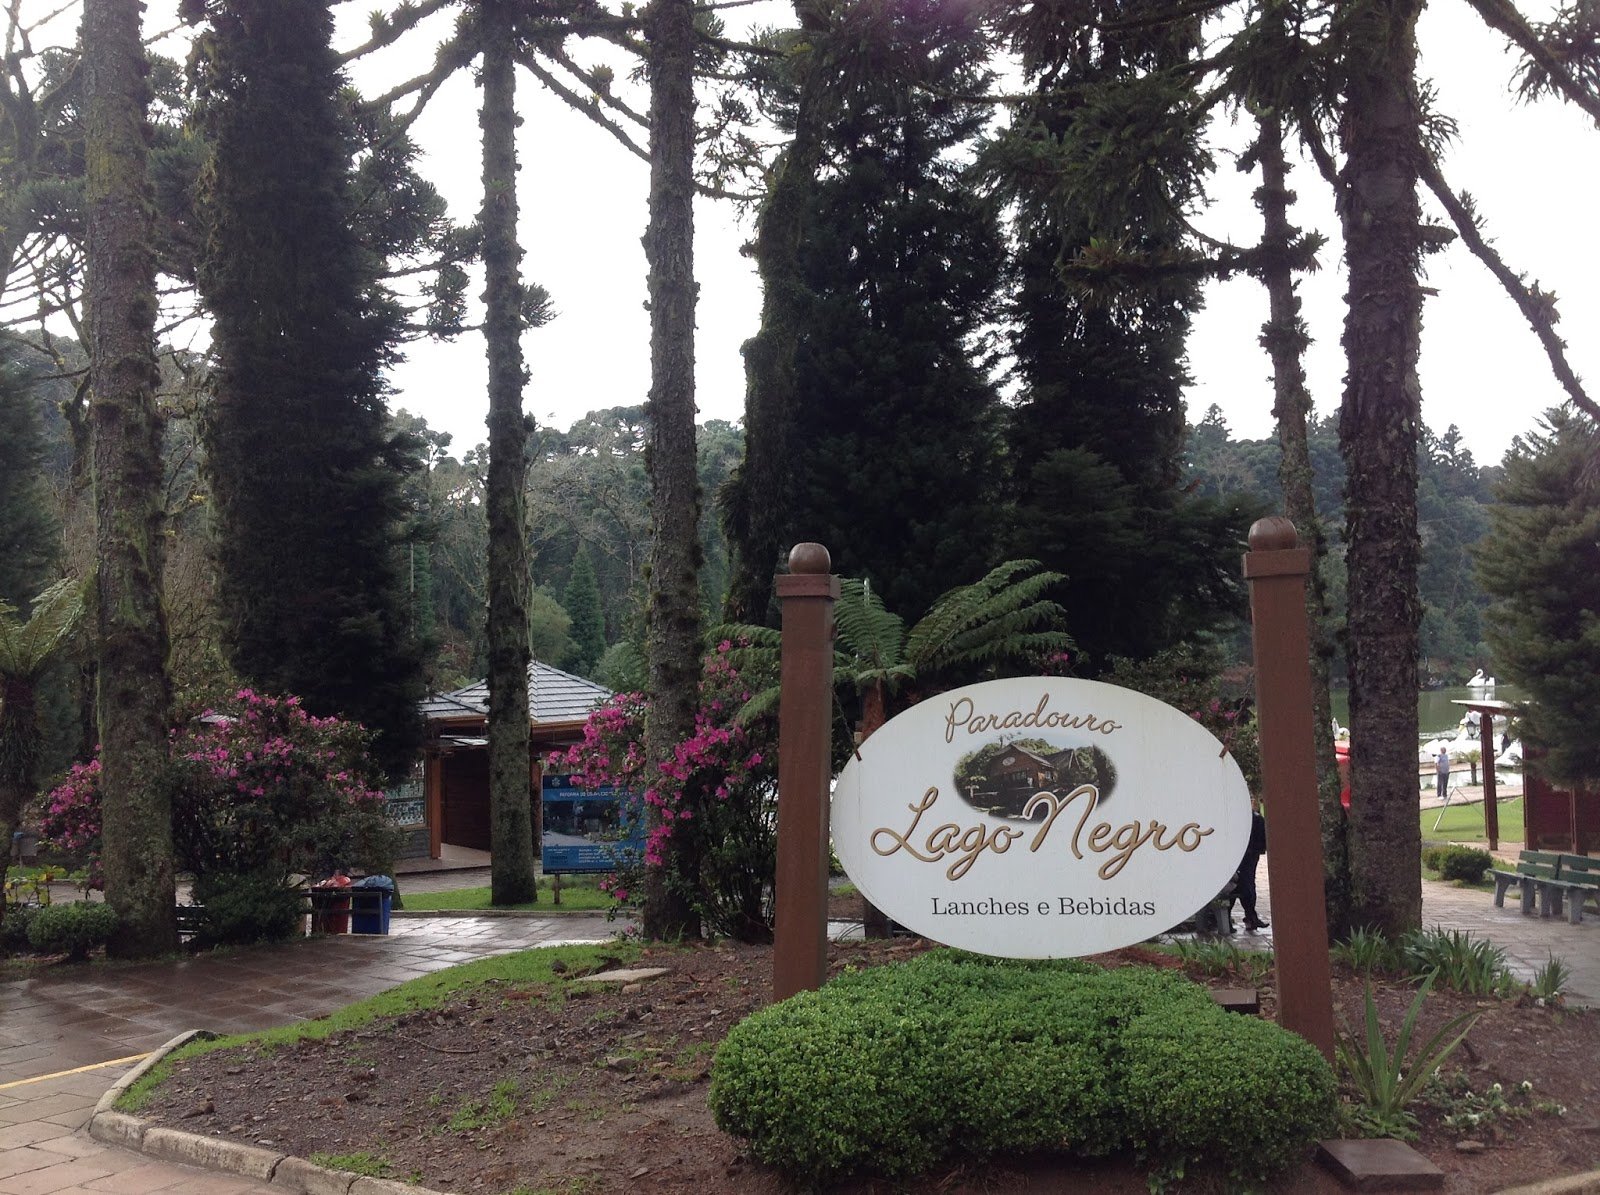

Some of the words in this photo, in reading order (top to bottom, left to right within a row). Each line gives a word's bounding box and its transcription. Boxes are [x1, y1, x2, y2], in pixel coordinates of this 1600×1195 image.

[945, 692, 1123, 744] Paradouro
[870, 786, 1024, 881] Lago
[1024, 785, 1215, 880] Negro
[931, 897, 1030, 916] Lanches
[1037, 900, 1050, 916] e
[1057, 897, 1156, 916] Bebidas
